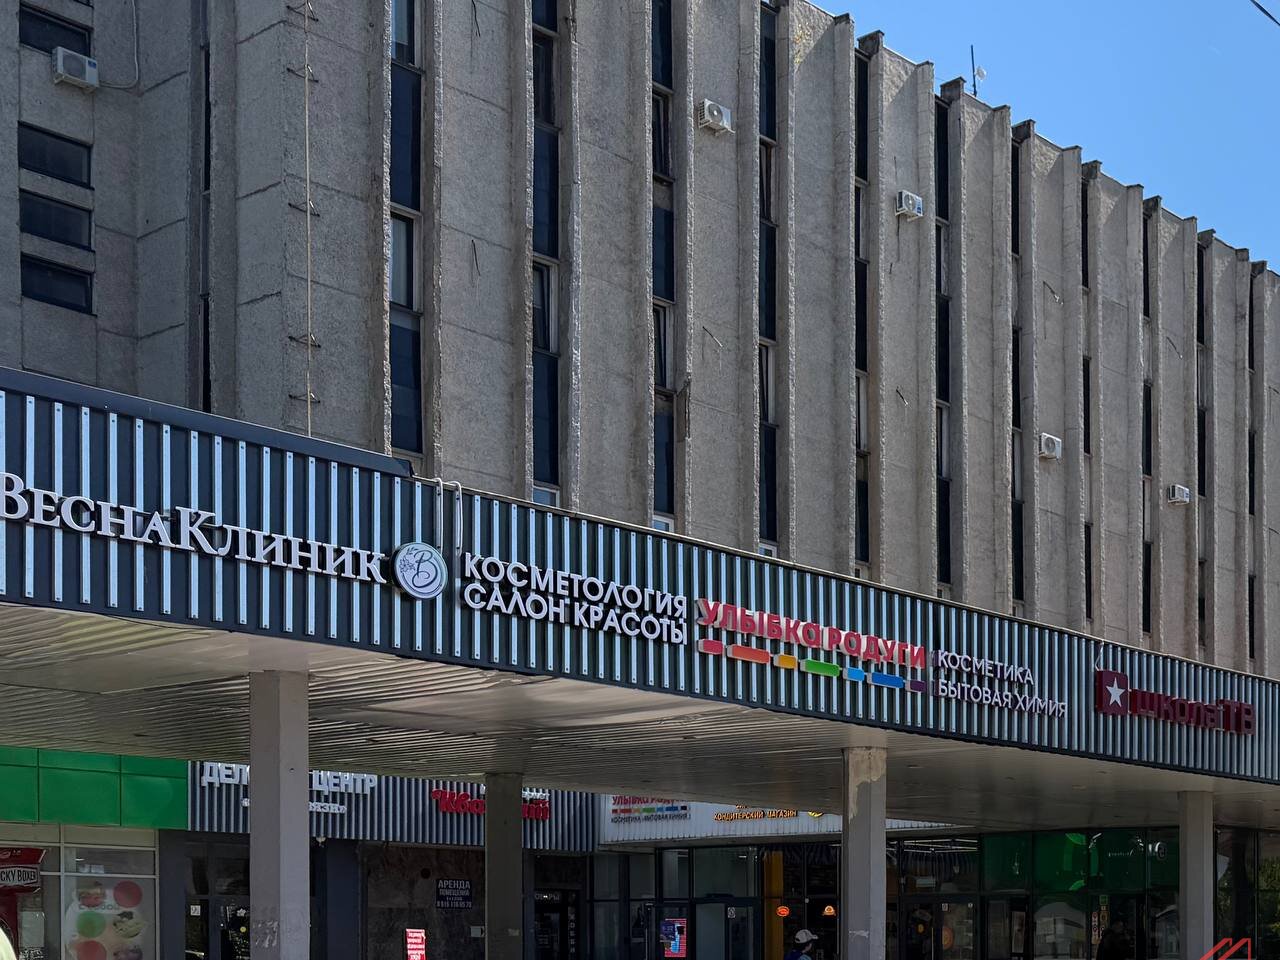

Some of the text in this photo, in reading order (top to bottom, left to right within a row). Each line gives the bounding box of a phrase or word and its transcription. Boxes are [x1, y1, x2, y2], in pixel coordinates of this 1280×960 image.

[464, 551, 688, 619] КОСМЕТОЛОГИЯ
[463, 582, 688, 646] САЛОН КРАСОТЫ
[938, 649, 1035, 686] КОСМЕТИКА
[938, 679, 1068, 718] БЫТОВАЯ ХИМИЯ
[312, 770, 378, 796] ЦЕНТР
[438, 880, 471, 889] АРЕНДА
